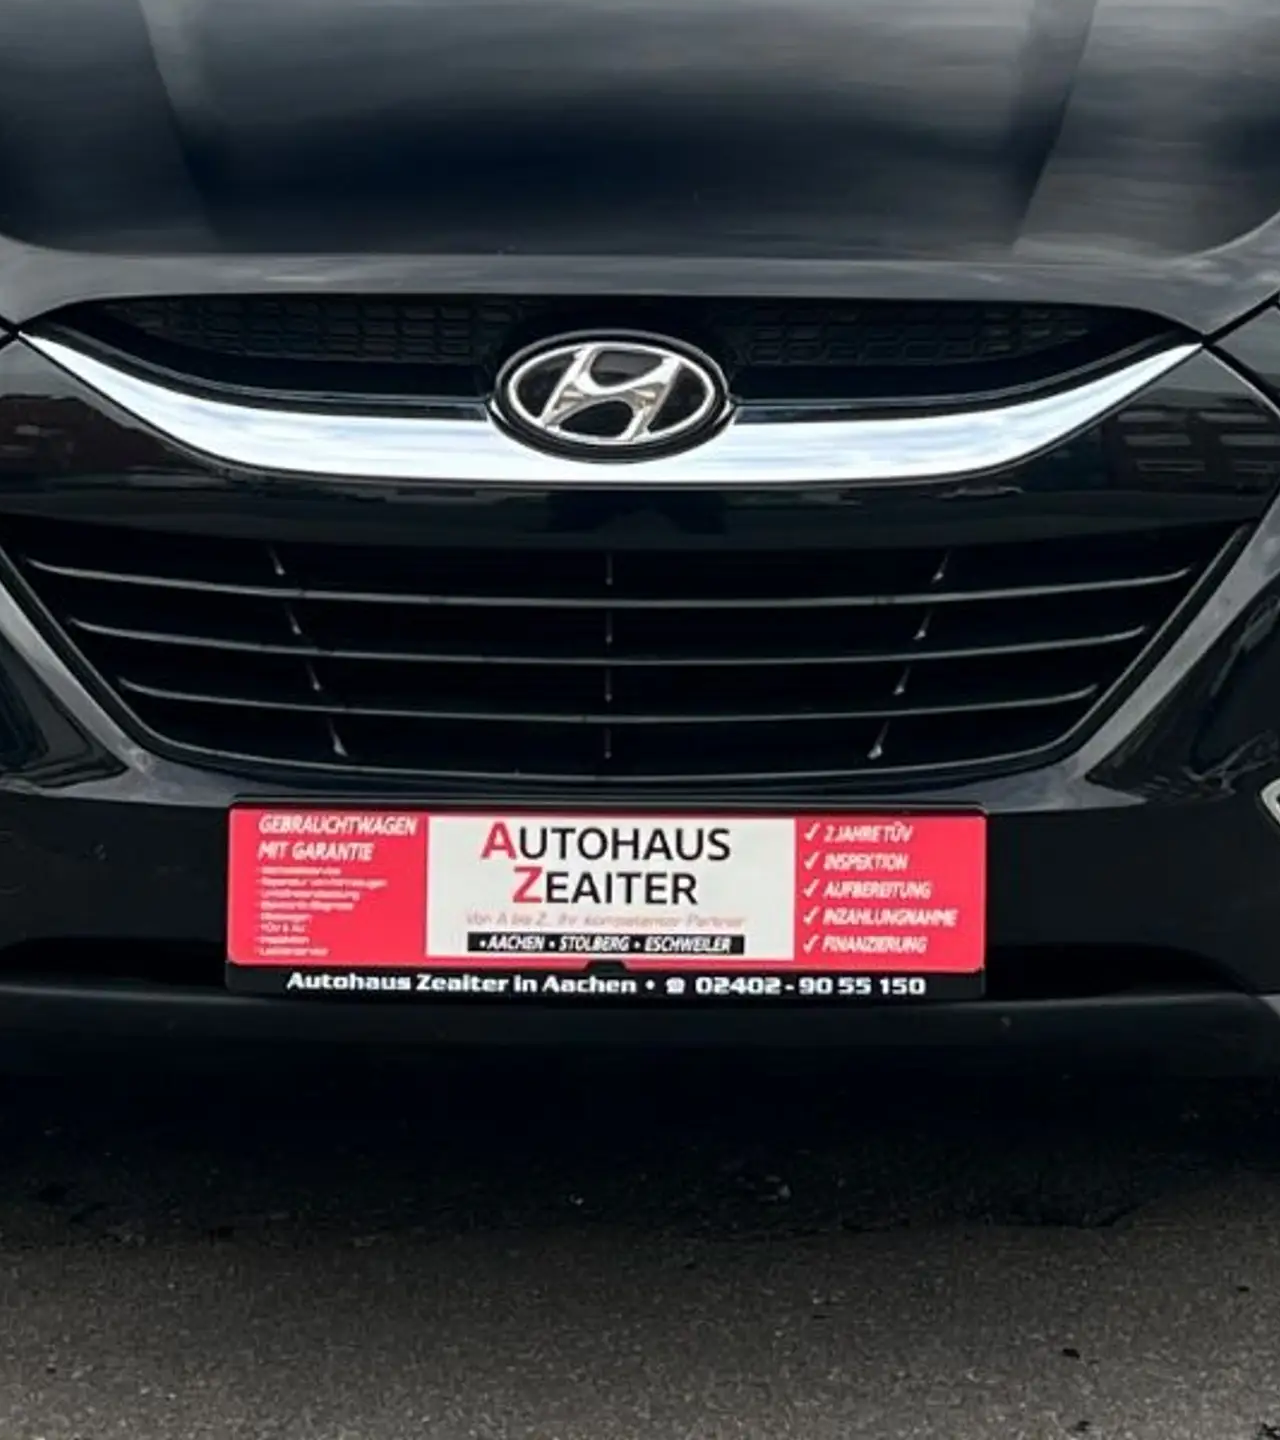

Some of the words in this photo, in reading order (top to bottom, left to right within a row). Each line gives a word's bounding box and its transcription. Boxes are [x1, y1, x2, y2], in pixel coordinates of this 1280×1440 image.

[258, 814, 419, 837] GEBRAUCHTWAGEN
[835, 825, 883, 843] JAHRE
[885, 820, 914, 843] TÜV
[257, 841, 289, 861] MIT
[292, 842, 375, 862] GARANTIE
[480, 821, 731, 862] AUTOHAUS
[823, 852, 909, 872] INSPEKTION
[512, 866, 698, 905] ZEAITER
[822, 880, 933, 900] AUFBEREITUNG
[486, 934, 544, 951] AACHEN
[558, 935, 630, 952] STOLBERG
[644, 936, 732, 953] ESCHWEILER
[821, 935, 929, 954] FINANZIERUNG
[287, 971, 412, 991] Autohaus
[416, 973, 511, 992] Zeaiter
[513, 974, 537, 993] in
[542, 975, 637, 994] Aachen
[799, 977, 833, 996] 90
[837, 977, 872, 996] 55
[879, 977, 927, 996] 150
